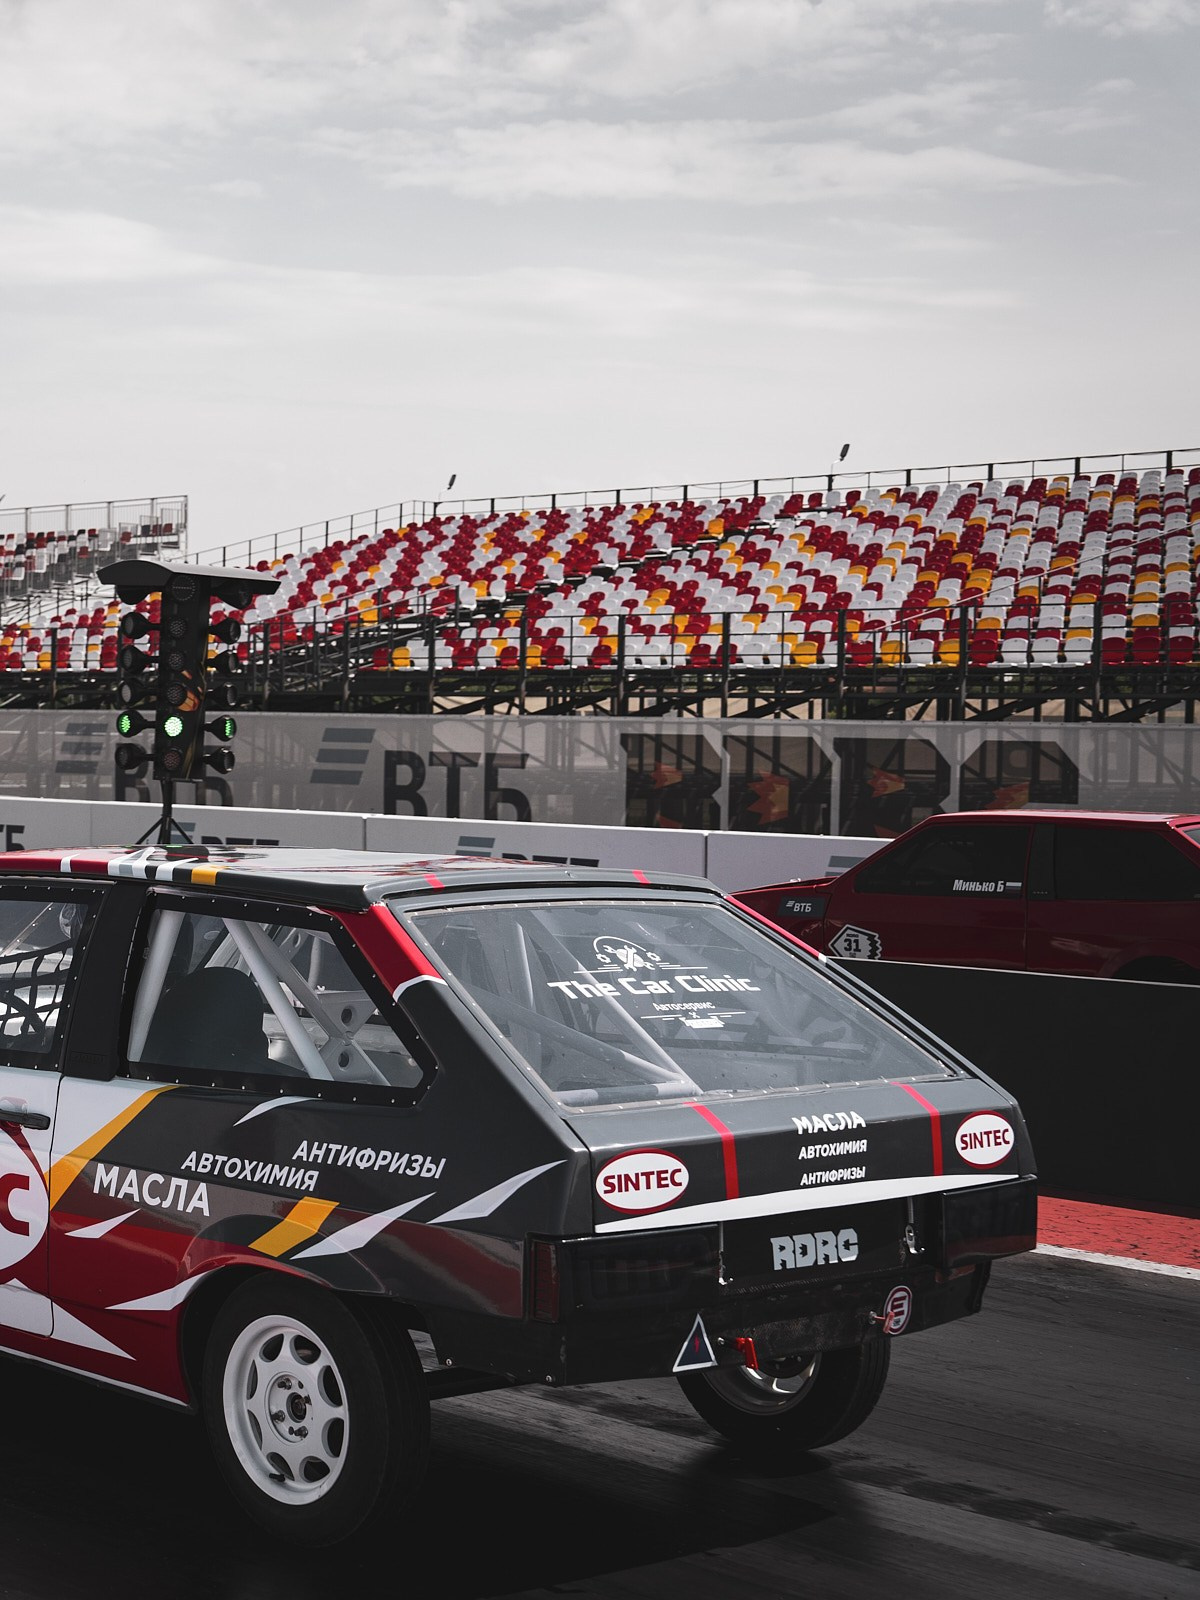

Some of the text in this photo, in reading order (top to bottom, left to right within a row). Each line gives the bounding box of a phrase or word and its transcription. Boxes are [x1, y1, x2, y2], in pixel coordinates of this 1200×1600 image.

[383, 750, 532, 823] ВТБ
[952, 879, 1004, 892] Минько Б
[794, 902, 812, 913] ВТБ
[844, 938, 861, 952] 31
[548, 974, 761, 999] The Car Clinic
[792, 1111, 866, 1134] МАСЛА
[798, 1139, 867, 1160] АВТОХИМИЯ
[960, 1127, 1011, 1150] SINTEC
[181, 1151, 319, 1192] АВТОХИМИЯ
[292, 1140, 447, 1179] АНТИФРИЗЫ
[603, 1168, 683, 1194] SINTEC
[800, 1166, 866, 1186] АНТИФРИЗЫ
[93, 1164, 210, 1217] МАСЛА
[770, 1229, 859, 1271] RDRC
